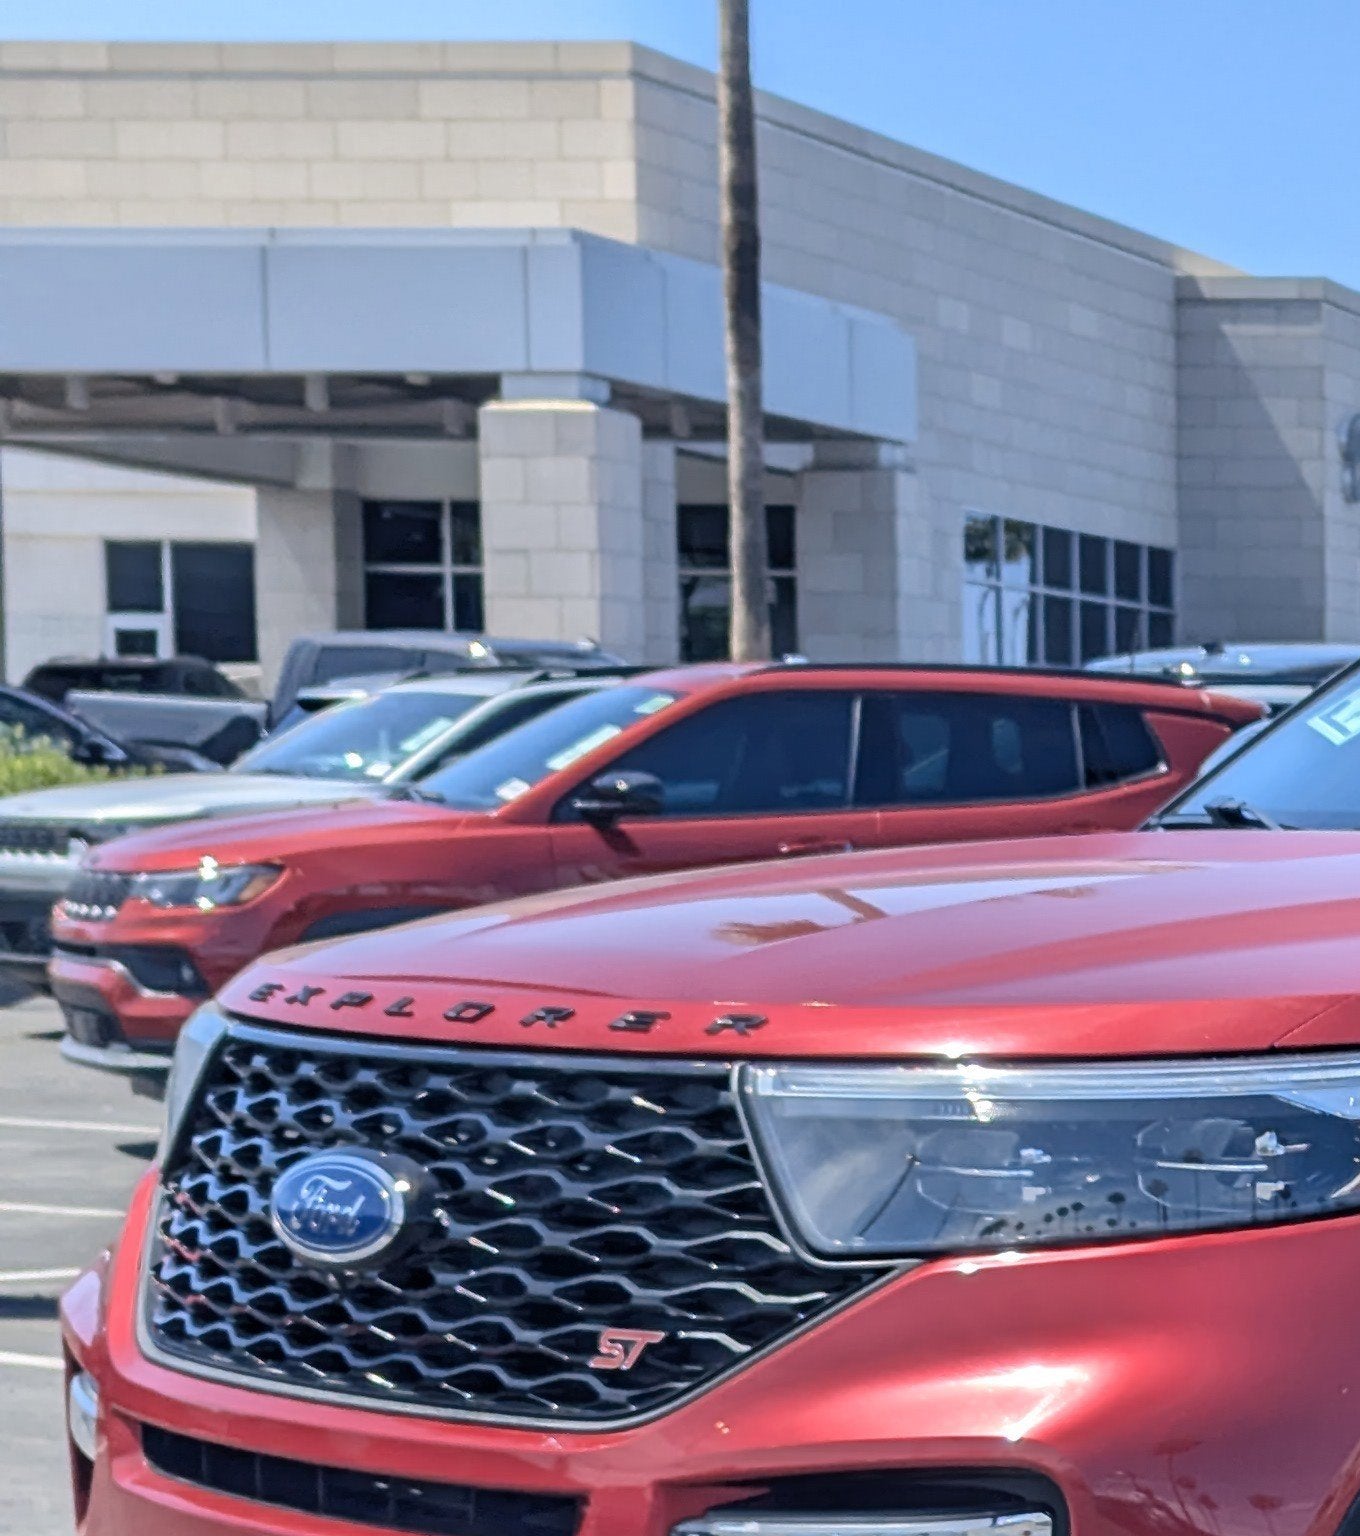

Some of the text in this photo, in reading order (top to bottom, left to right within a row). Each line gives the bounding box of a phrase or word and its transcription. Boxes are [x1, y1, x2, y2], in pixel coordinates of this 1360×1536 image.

[247, 982, 768, 1037] EXPLORER
[289, 1174, 367, 1236] Ford
[586, 1327, 667, 1371] ST
